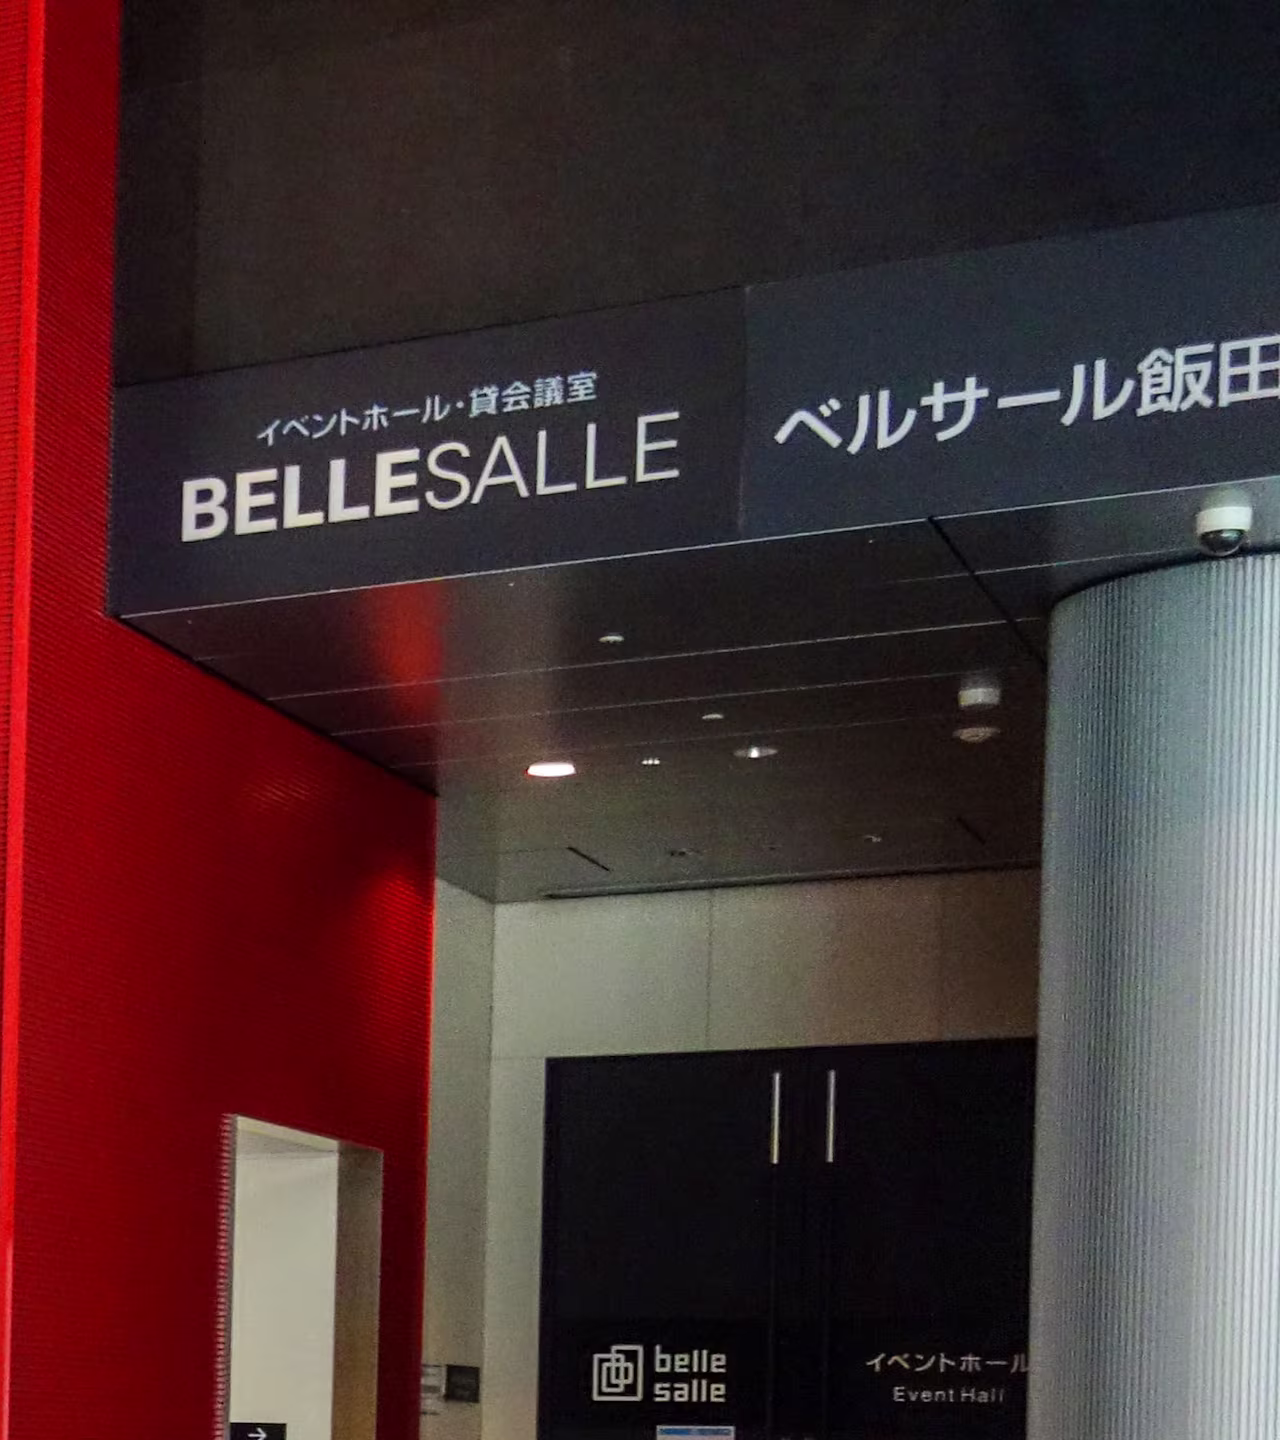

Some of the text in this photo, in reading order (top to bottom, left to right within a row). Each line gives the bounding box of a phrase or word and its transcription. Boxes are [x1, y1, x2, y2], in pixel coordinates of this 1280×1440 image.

[256, 370, 598, 448] イベントホール・貸会議室
[773, 333, 1280, 455] ベルサール飯田
[181, 411, 680, 543] BELLESALLE
[654, 1343, 727, 1373] belle
[653, 1378, 727, 1403] salle
[893, 1386, 1005, 1403] Event Hall
